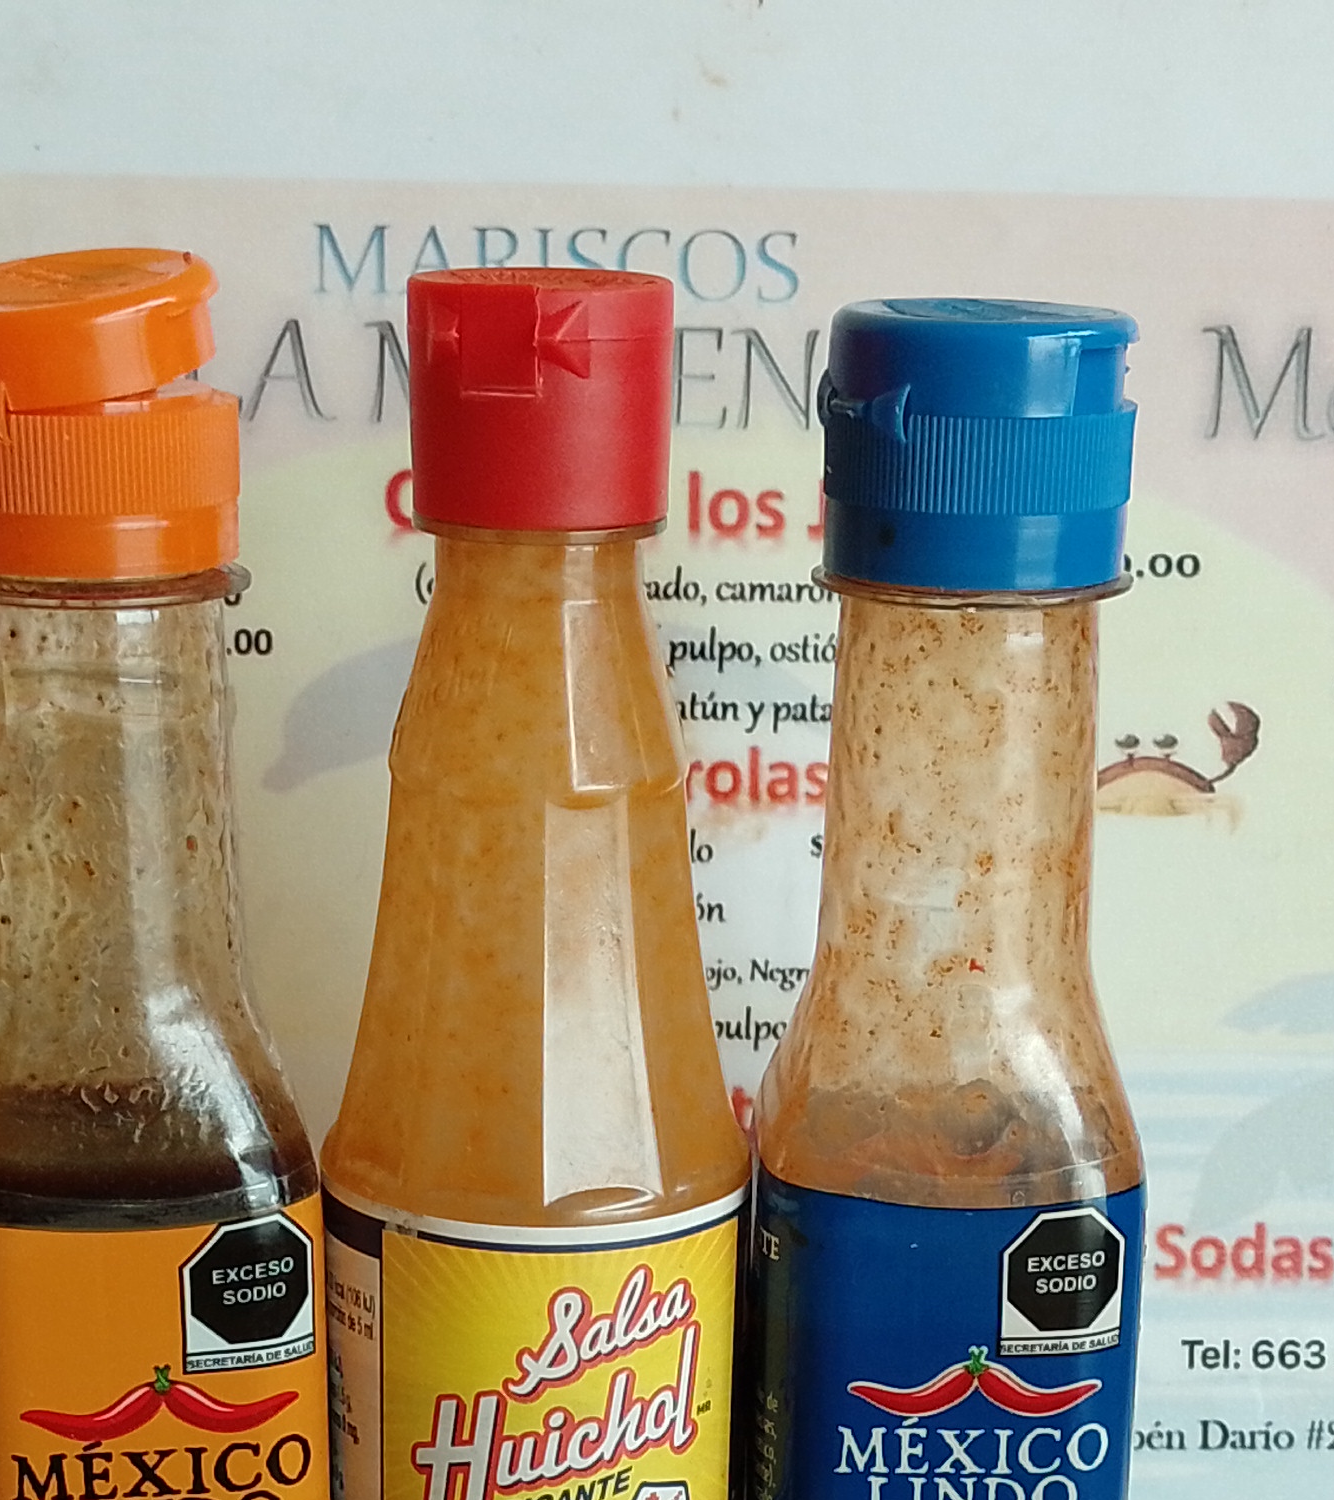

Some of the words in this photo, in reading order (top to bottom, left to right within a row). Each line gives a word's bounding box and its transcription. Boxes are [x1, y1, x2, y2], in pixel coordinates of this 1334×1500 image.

[313, 223, 800, 302] MARISCOS
[688, 470, 786, 539] los
[668, 626, 762, 673] pulpo,
[745, 701, 766, 733] y
[1027, 1250, 1106, 1275] EXCESO
[1153, 1222, 1334, 1282] Sodas
[212, 1257, 295, 1286] EXCESO
[1036, 1274, 1097, 1296] SODIO
[222, 1282, 287, 1306] SODIO
[509, 1266, 692, 1395] Salsa
[187, 1352, 264, 1369] SECRETARÍA
[266, 1350, 282, 1361] DE
[1001, 1341, 1069, 1354] SECRETARÍA
[1072, 1341, 1086, 1351] DE
[1182, 1340, 1241, 1370] Tel:
[1251, 1339, 1327, 1370] 663
[834, 1418, 1108, 1475] MÉXICO
[1199, 1419, 1295, 1451] Darío
